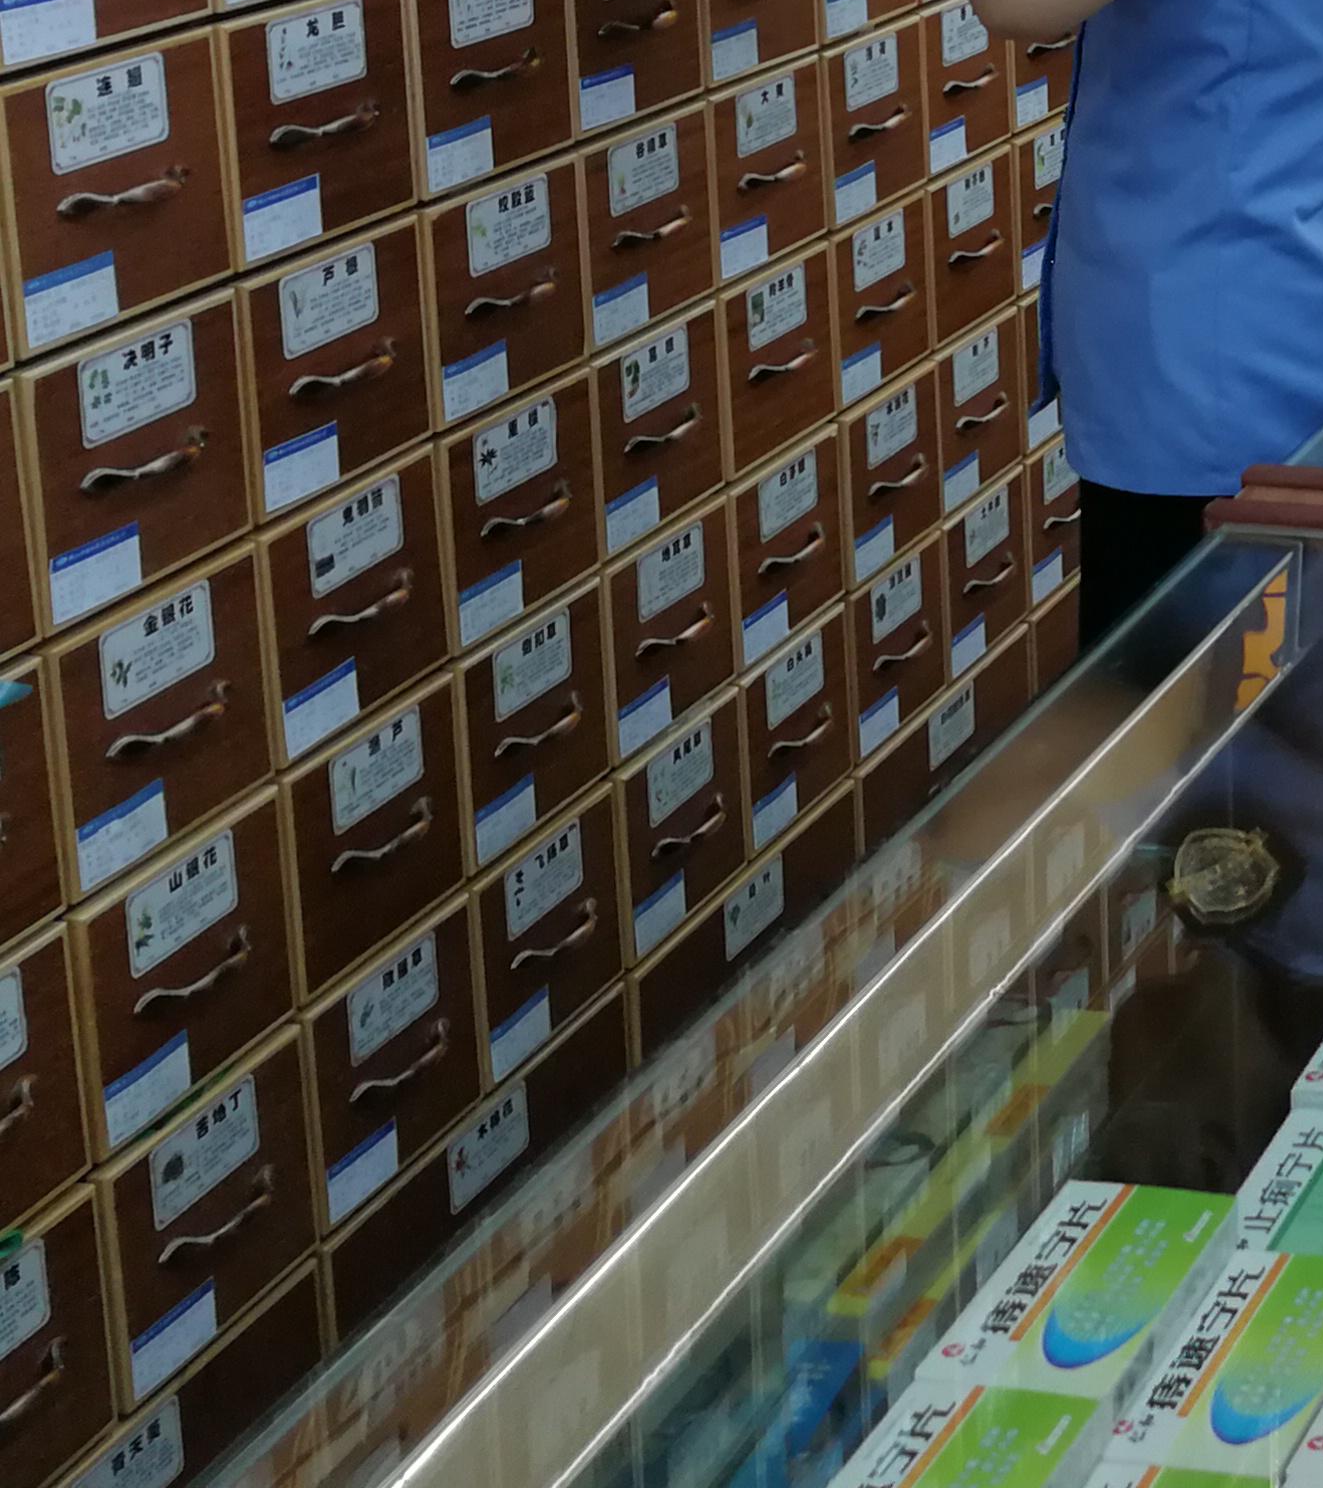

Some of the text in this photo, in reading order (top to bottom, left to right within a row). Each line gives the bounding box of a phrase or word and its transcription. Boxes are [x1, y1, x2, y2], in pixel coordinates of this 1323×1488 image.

[305, 10, 346, 38] 龙胆
[96, 65, 143, 98] 连翘
[635, 131, 667, 160] 谷精草
[498, 184, 536, 214] 绞股蓝
[322, 255, 359, 286] 芦根
[123, 333, 175, 372] 决明子
[142, 595, 195, 638] 金银花
[167, 846, 218, 894] 山银花
[195, 1087, 242, 1140] 苦地丁
[981, 1197, 1108, 1335] 痔速宁片
[1145, 1265, 1265, 1412] 痔速宁片
